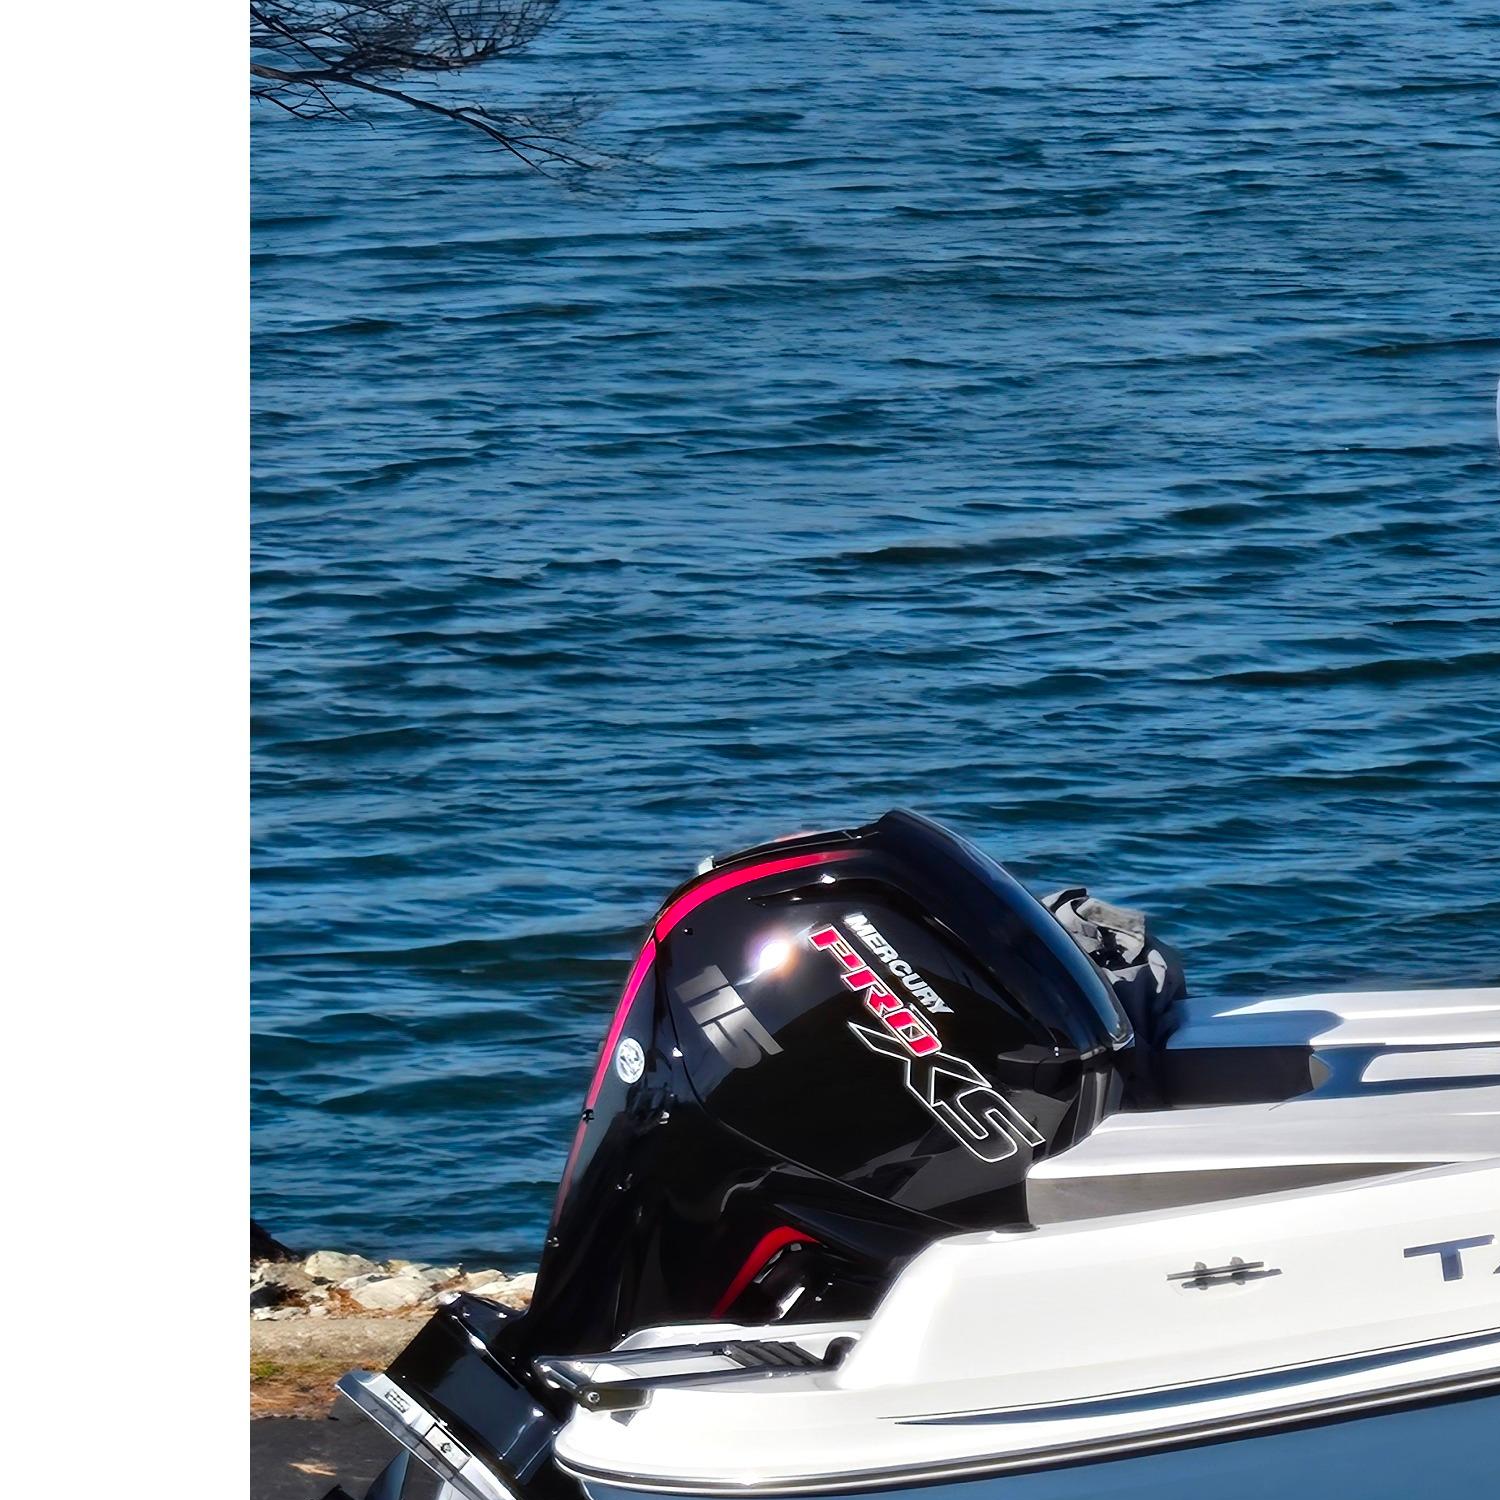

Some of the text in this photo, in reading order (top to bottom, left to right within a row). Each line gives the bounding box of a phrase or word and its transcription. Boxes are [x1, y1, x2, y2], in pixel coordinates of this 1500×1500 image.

[675, 965, 784, 1069] 115
[808, 925, 942, 1057] PRO
[844, 912, 954, 1013] MERCURY
[848, 1020, 1046, 1163] XS
